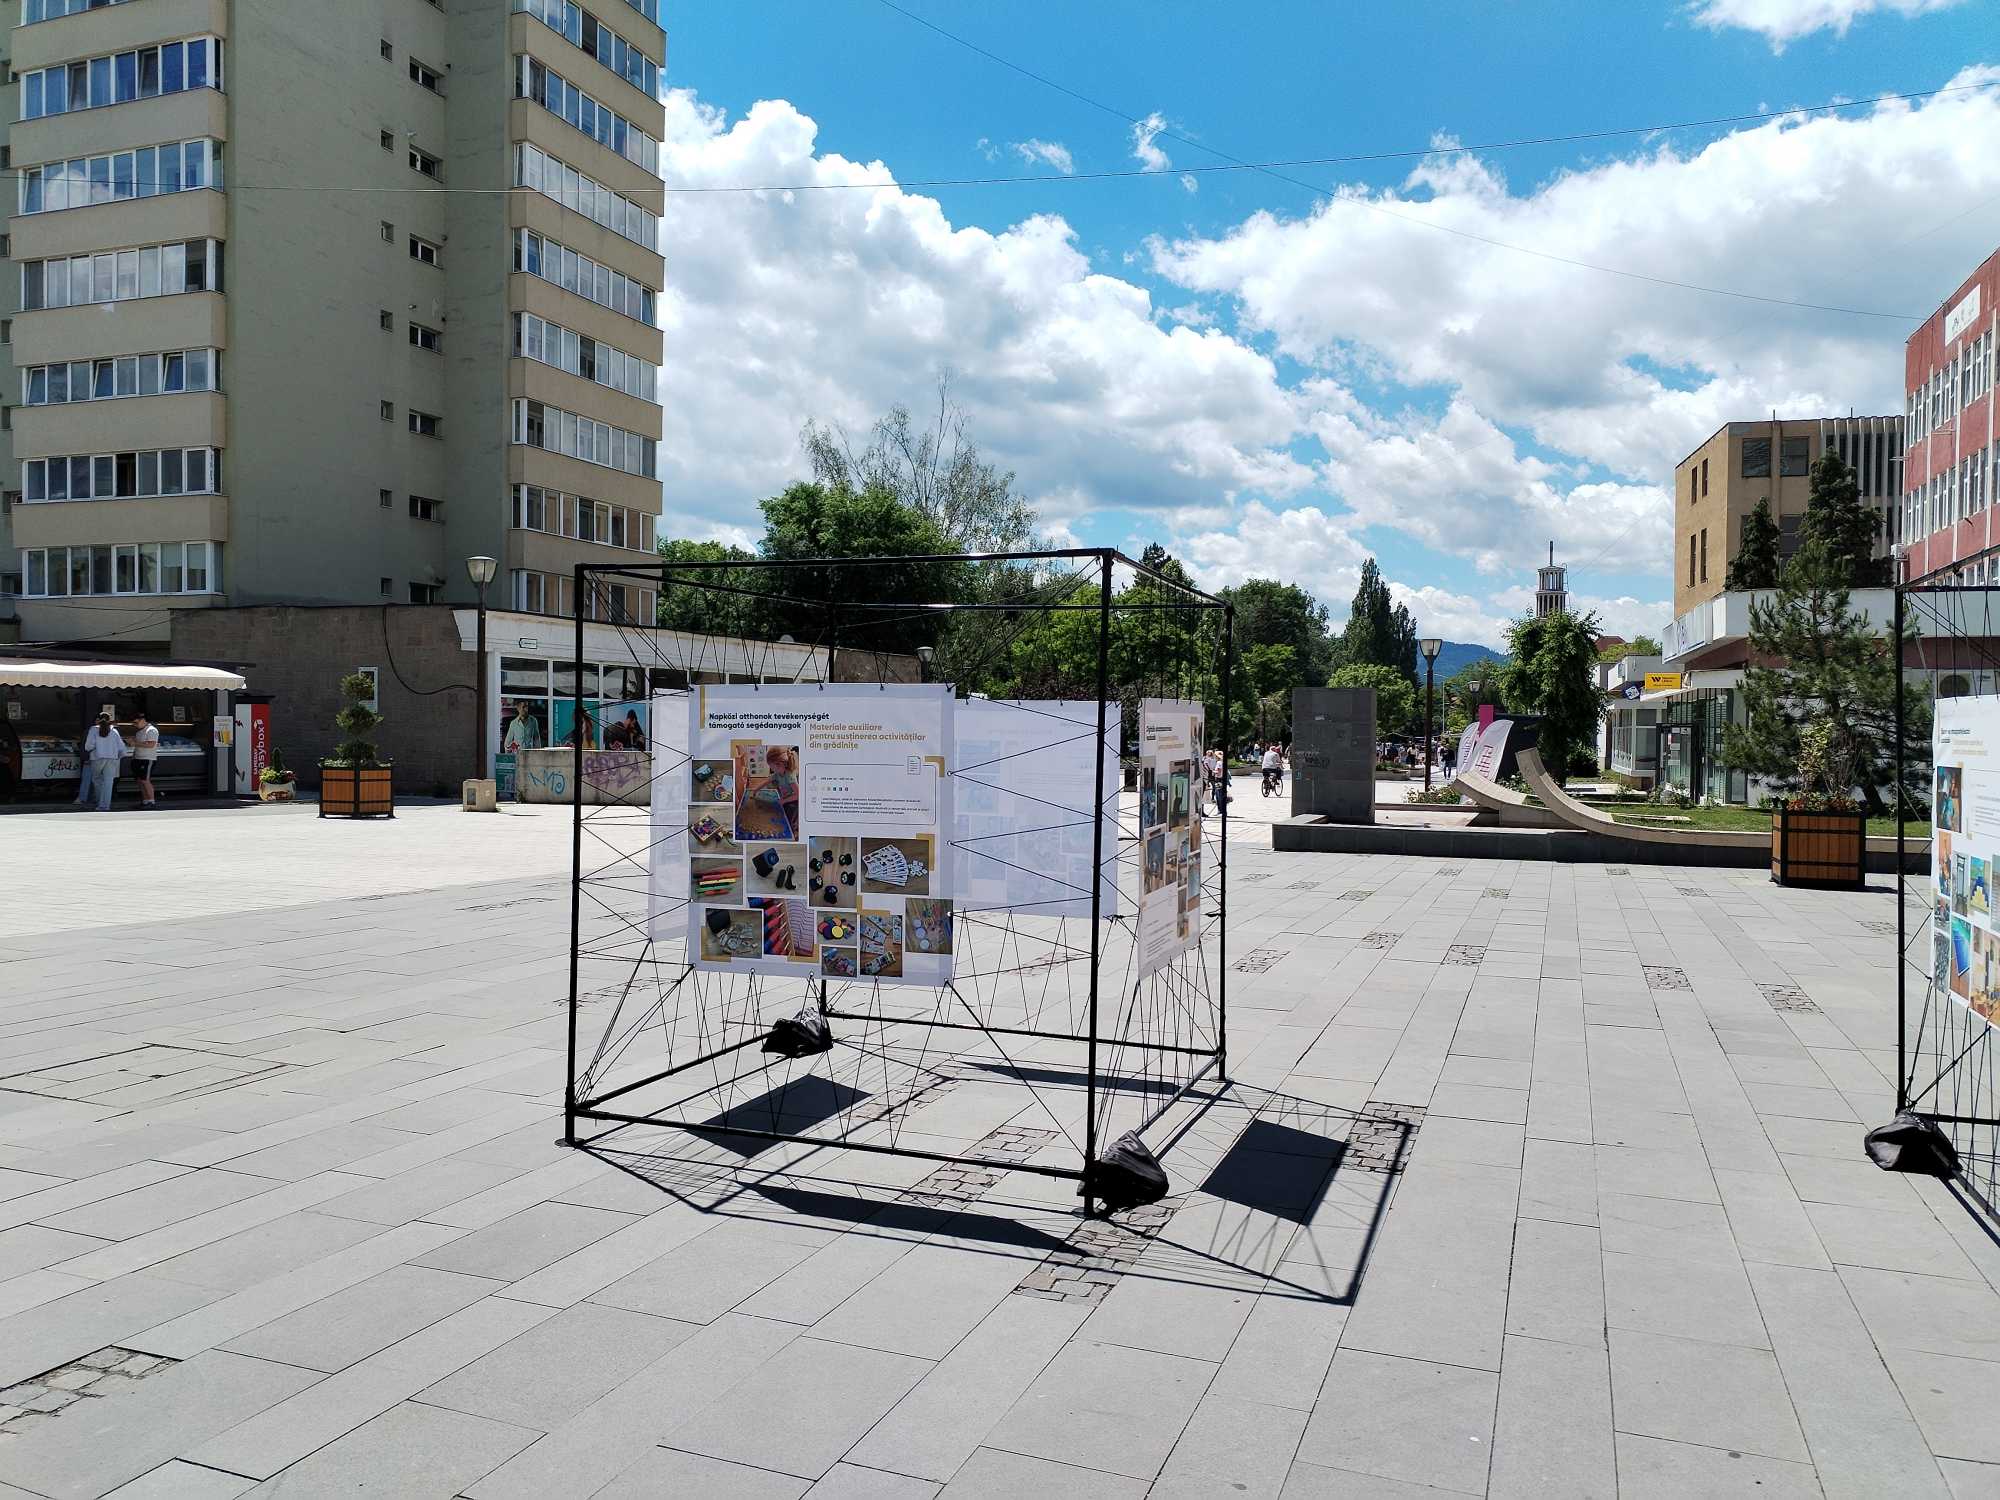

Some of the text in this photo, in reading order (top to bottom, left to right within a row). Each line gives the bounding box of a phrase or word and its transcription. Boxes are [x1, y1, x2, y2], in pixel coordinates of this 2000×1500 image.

[709, 712, 830, 721] Napközi otthonok tevékenységét
[709, 721, 802, 730] támogató segédanyagok
[809, 723, 882, 731] Materiale auxiliare
[809, 732, 836, 741] pentru
[809, 741, 821, 749] din
